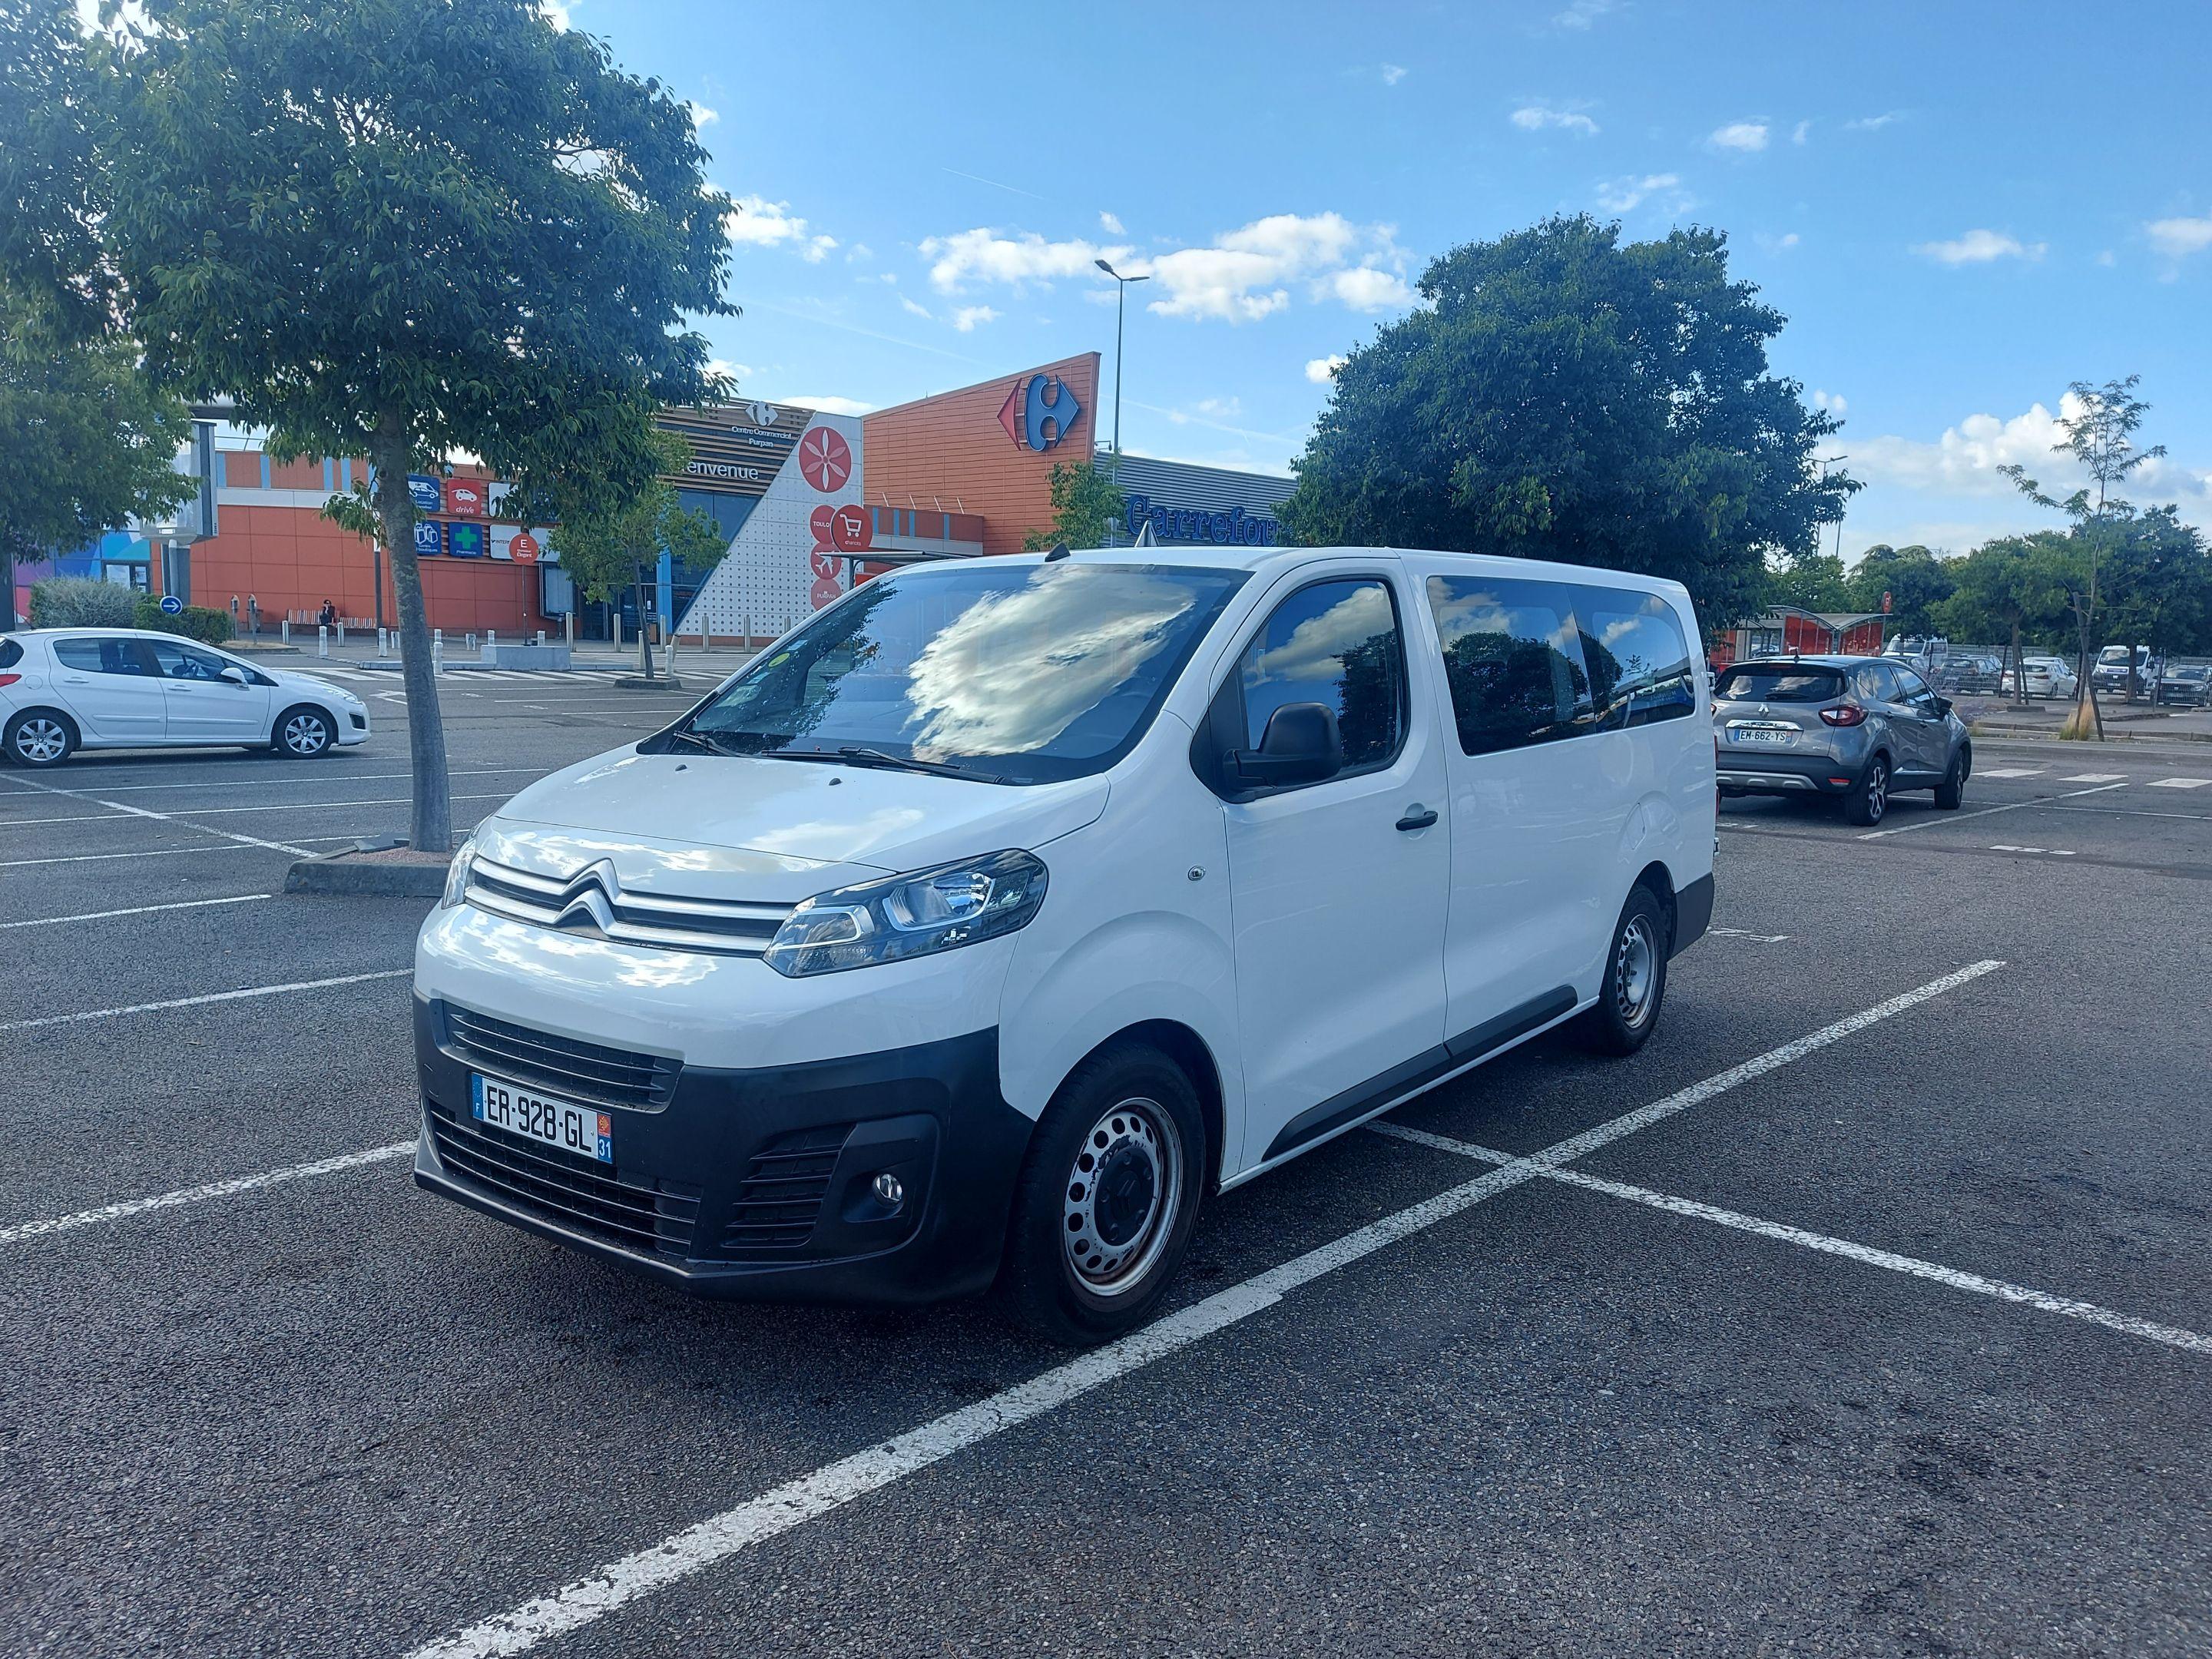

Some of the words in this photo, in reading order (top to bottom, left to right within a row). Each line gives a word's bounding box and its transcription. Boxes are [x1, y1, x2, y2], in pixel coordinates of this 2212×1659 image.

[731, 426, 753, 435] Centre
[753, 429, 792, 439] Commercial
[748, 438, 774, 448] Purpan
[687, 461, 759, 480] envenue
[1125, 494, 1280, 547] Carrefou
[520, 539, 528, 548] E
[1740, 730, 1786, 741] EM-662-YS
[475, 1102, 480, 1113] F
[486, 1084, 592, 1153] ER-928-GL
[598, 1139, 611, 1159] 31
